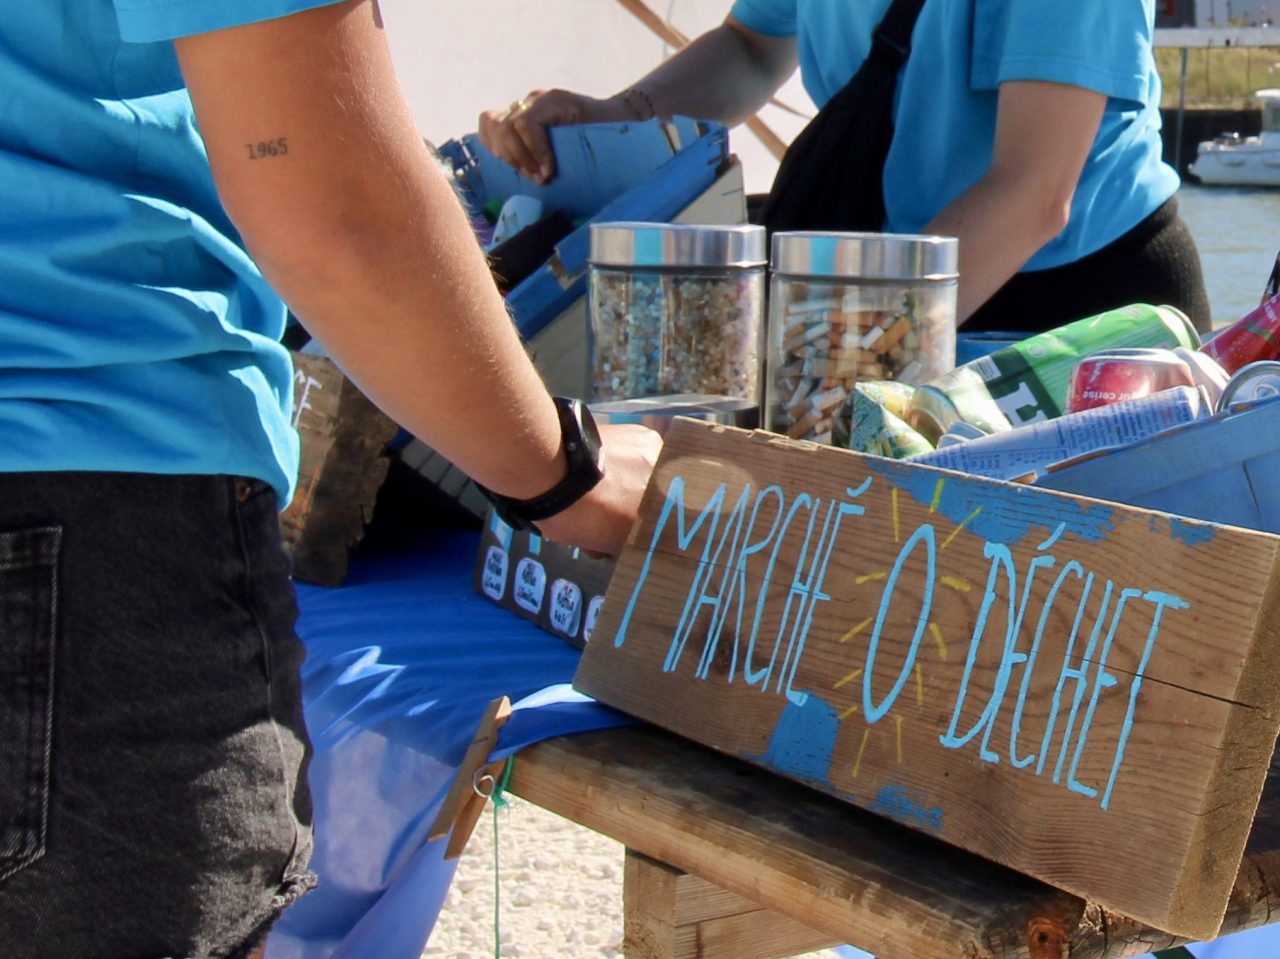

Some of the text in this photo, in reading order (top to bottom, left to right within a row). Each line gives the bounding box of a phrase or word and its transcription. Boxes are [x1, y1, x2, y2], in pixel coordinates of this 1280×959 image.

[245, 136, 288, 160] 1965
[614, 474, 872, 709] MARCHÉ
[939, 521, 1191, 813] DÉCHET
